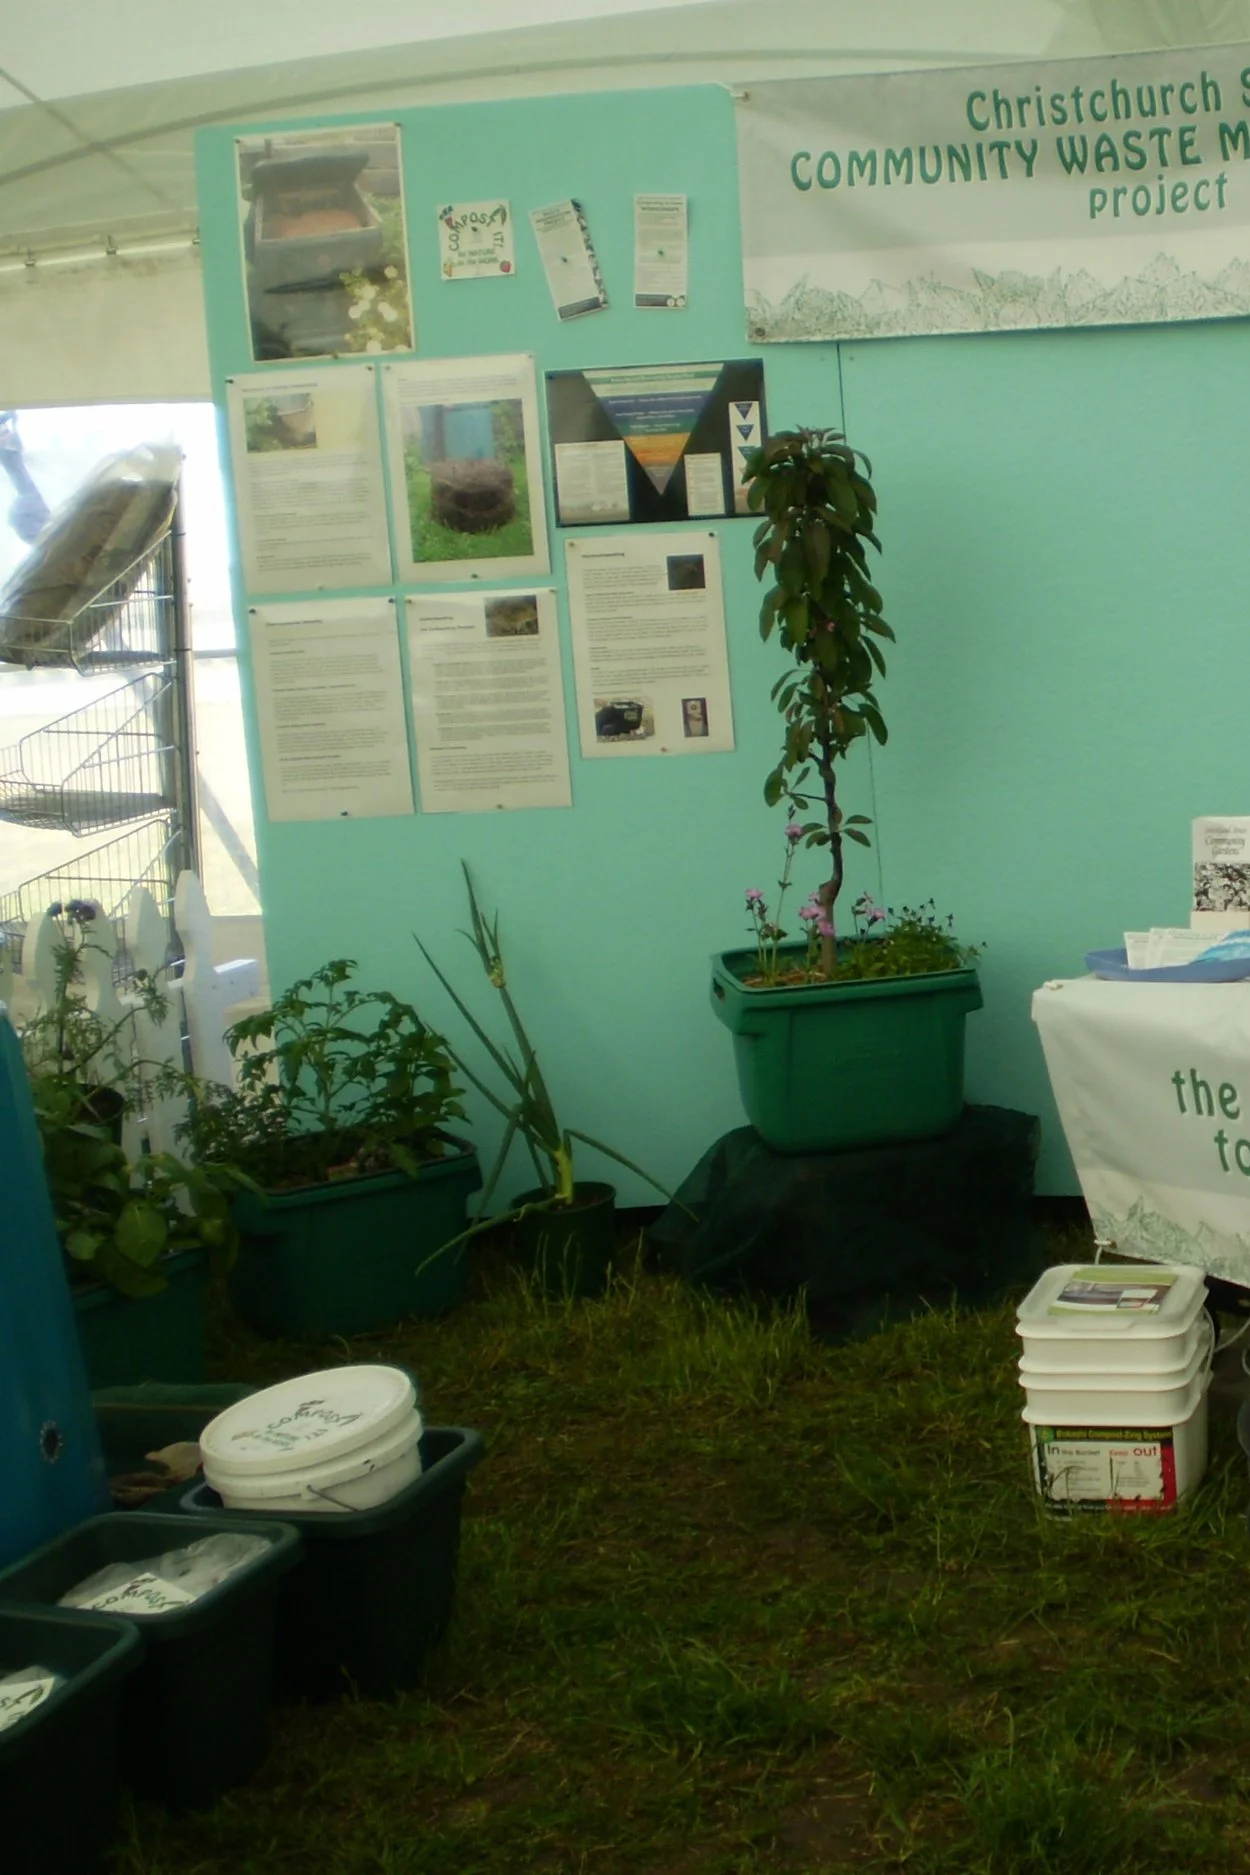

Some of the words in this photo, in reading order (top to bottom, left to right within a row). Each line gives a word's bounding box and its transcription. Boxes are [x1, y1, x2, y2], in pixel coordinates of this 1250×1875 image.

[965, 78, 1223, 131] Christchurch
[789, 136, 1038, 191] COMMUNITY
[1055, 123, 1202, 176] WASTE
[1088, 174, 1229, 220] project
[1171, 1068, 1240, 1120] the
